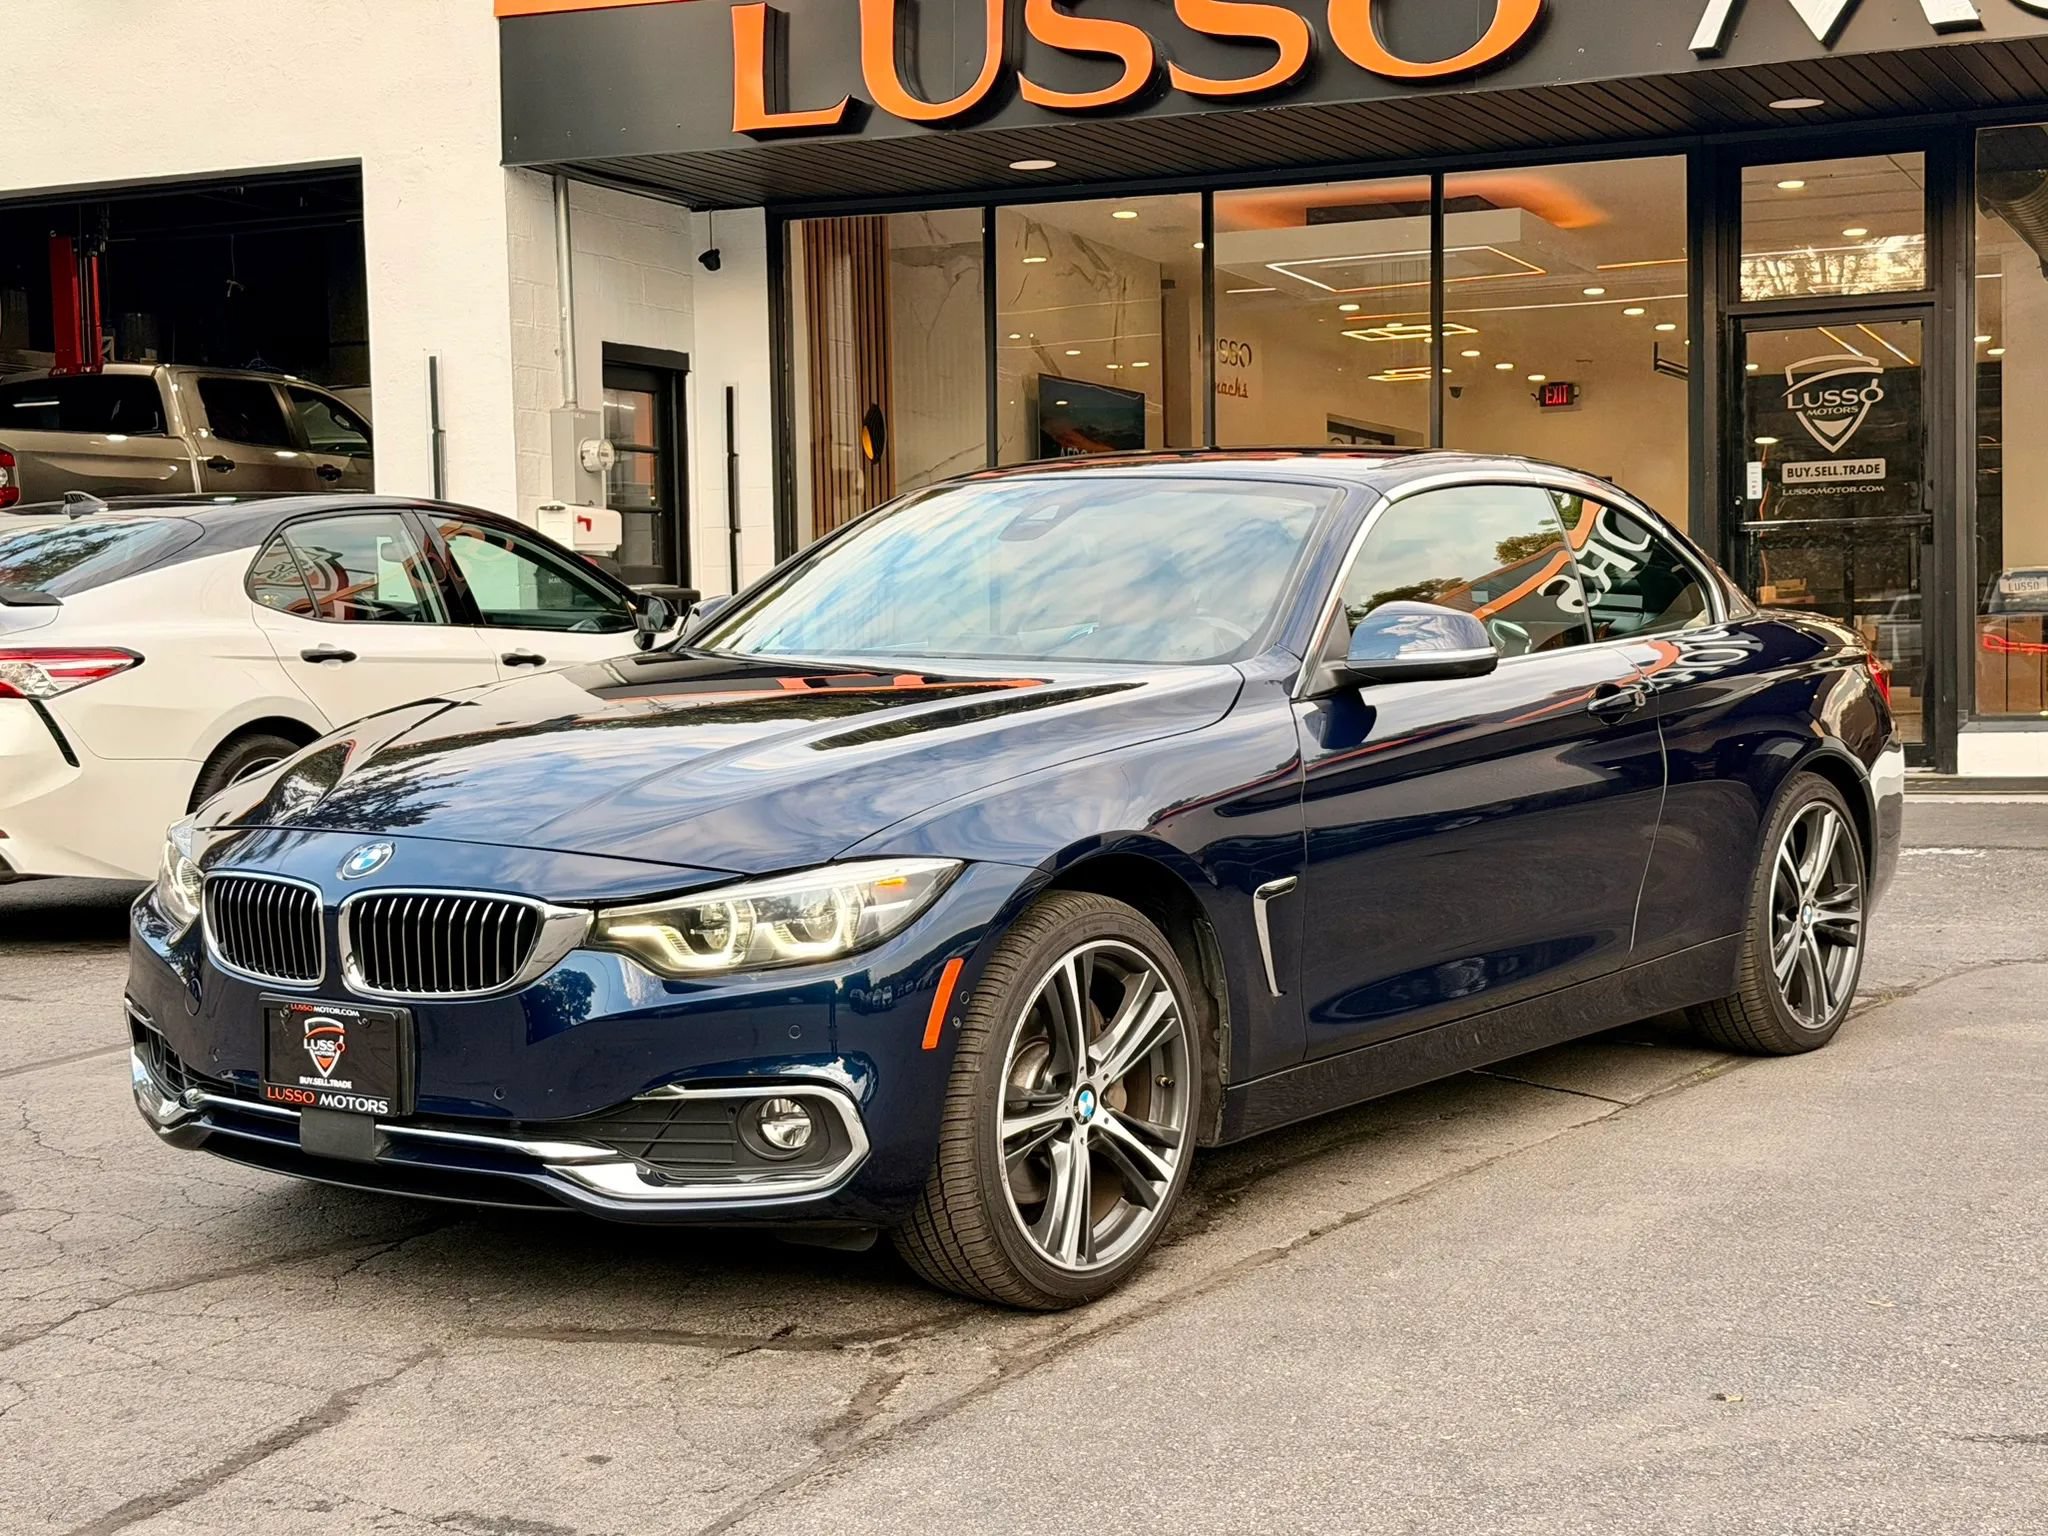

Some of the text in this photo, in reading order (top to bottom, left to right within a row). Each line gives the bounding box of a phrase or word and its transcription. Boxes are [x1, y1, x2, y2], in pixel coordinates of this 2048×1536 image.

[731, 0, 1546, 132] LUSSO
[1545, 385, 1569, 404] EXIT
[1787, 386, 1884, 409] LUSSO
[1806, 405, 1859, 416] MOTORS
[1786, 463, 1881, 478] BUY.SELL.TRADE
[1781, 485, 1885, 496] LUSSOMOTOR.COM
[291, 1004, 360, 1016] LUSSOMOTOR.COM
[303, 1038, 346, 1053] LUSSO
[267, 1087, 388, 1114] LUSSO MOTORS
